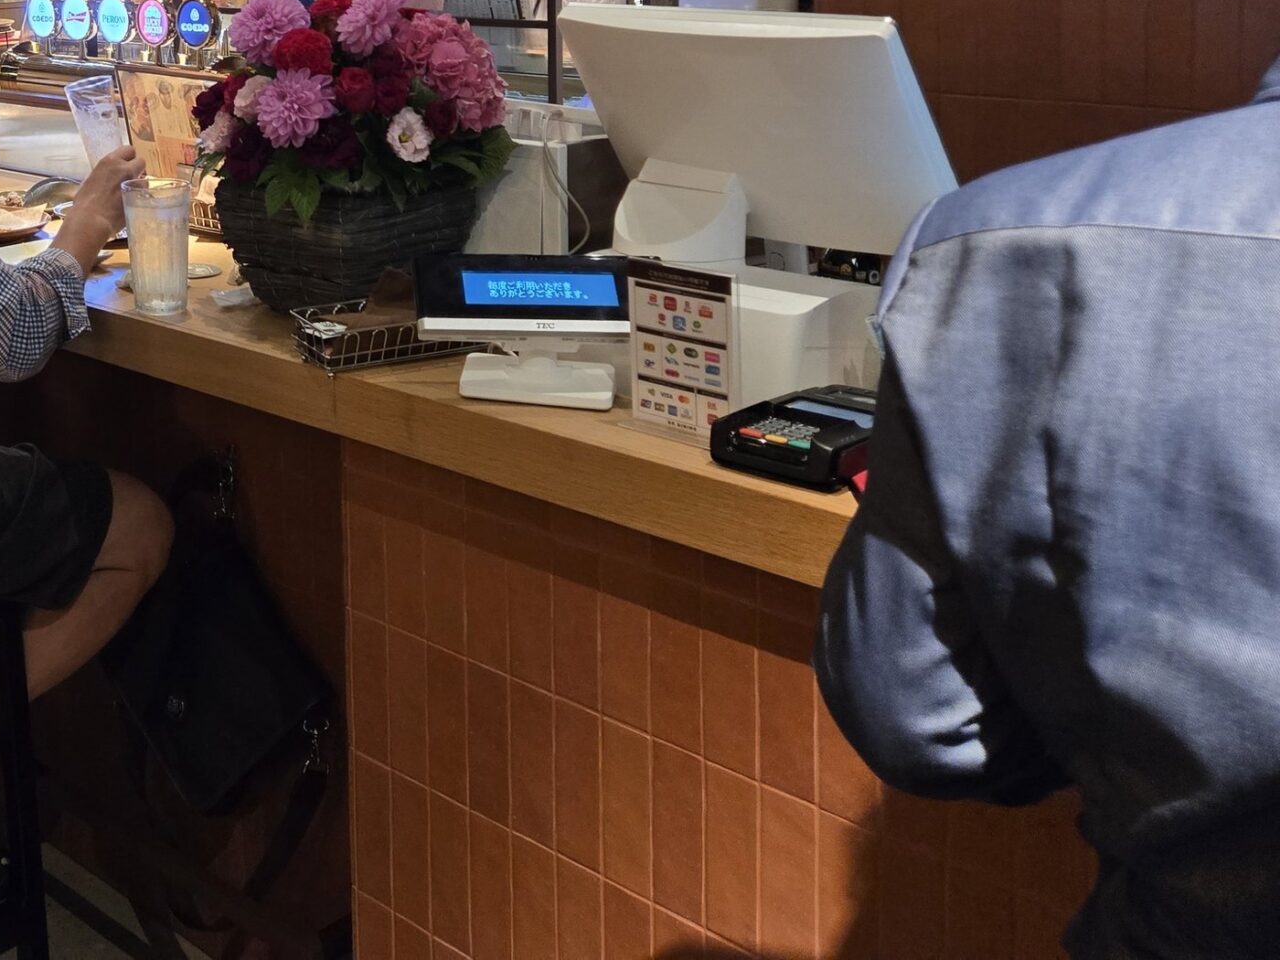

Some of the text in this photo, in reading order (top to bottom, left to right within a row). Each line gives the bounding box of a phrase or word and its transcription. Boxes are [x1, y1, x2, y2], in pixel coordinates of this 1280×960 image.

[32, 15, 53, 23] COEDO
[181, 22, 209, 32] COEDO
[488, 280, 572, 291] 毎度ご利用いただき
